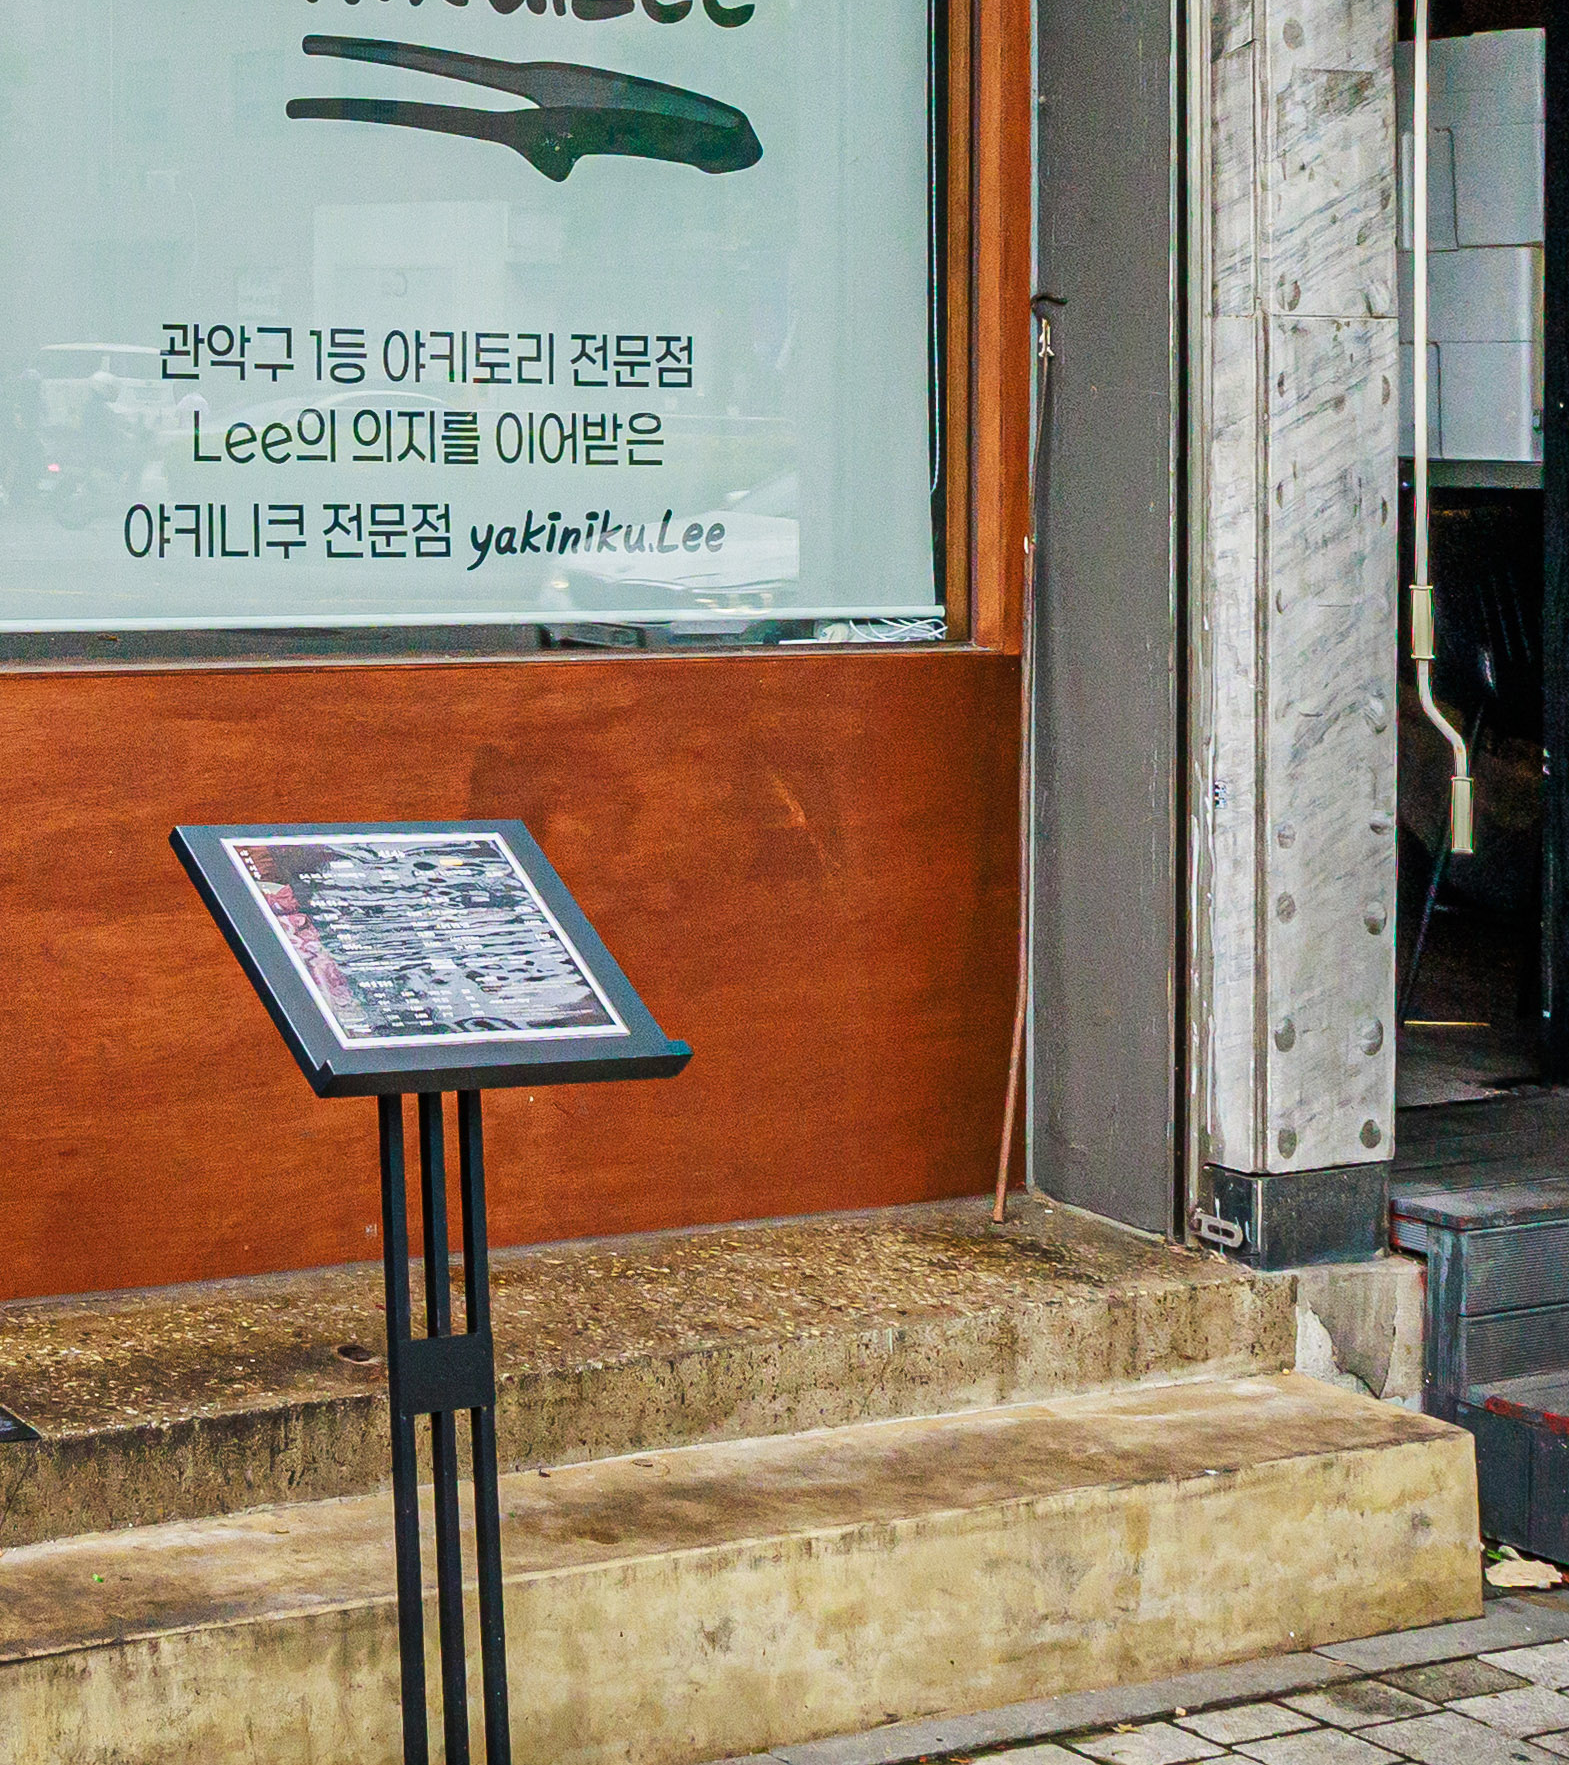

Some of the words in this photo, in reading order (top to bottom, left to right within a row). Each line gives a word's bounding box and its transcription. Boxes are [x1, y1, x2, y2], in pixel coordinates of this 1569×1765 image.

[160, 324, 295, 383] 관악구
[311, 327, 367, 383] 1등
[383, 331, 554, 386] 야키토리
[570, 334, 694, 388] 전문점
[193, 408, 337, 464] Lee의
[352, 410, 480, 465] 의지를
[495, 411, 664, 466] 이어받은
[124, 503, 308, 559] 야키니쿠
[321, 504, 451, 559] 전문점
[467, 507, 725, 571] yakiniku.Lee
